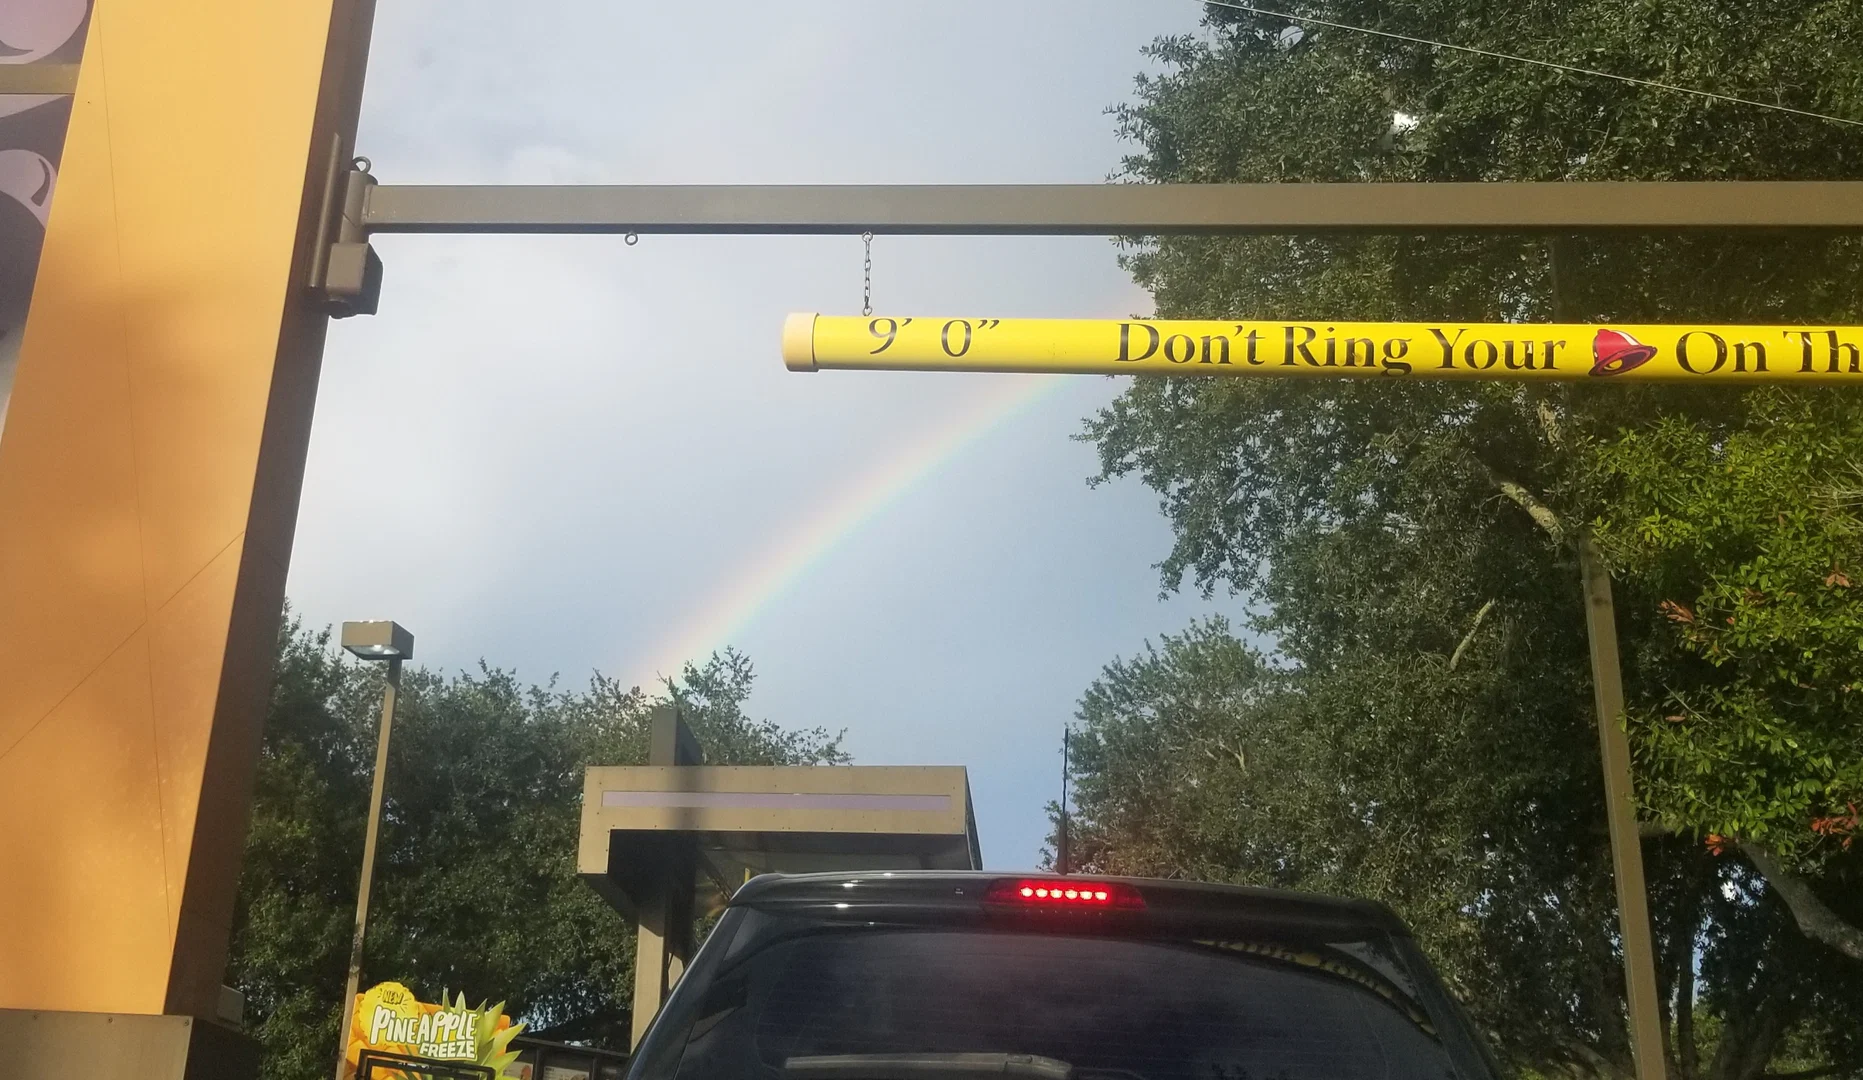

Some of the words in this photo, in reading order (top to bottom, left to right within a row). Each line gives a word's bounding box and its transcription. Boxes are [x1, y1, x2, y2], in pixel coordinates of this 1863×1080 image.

[1116, 323, 1265, 363] Don't
[1280, 325, 1413, 377] Ring
[1428, 328, 1567, 371] Your
[1675, 331, 1768, 375] On
[382, 990, 404, 1005] NEW
[420, 1041, 475, 1058] FREEZE
